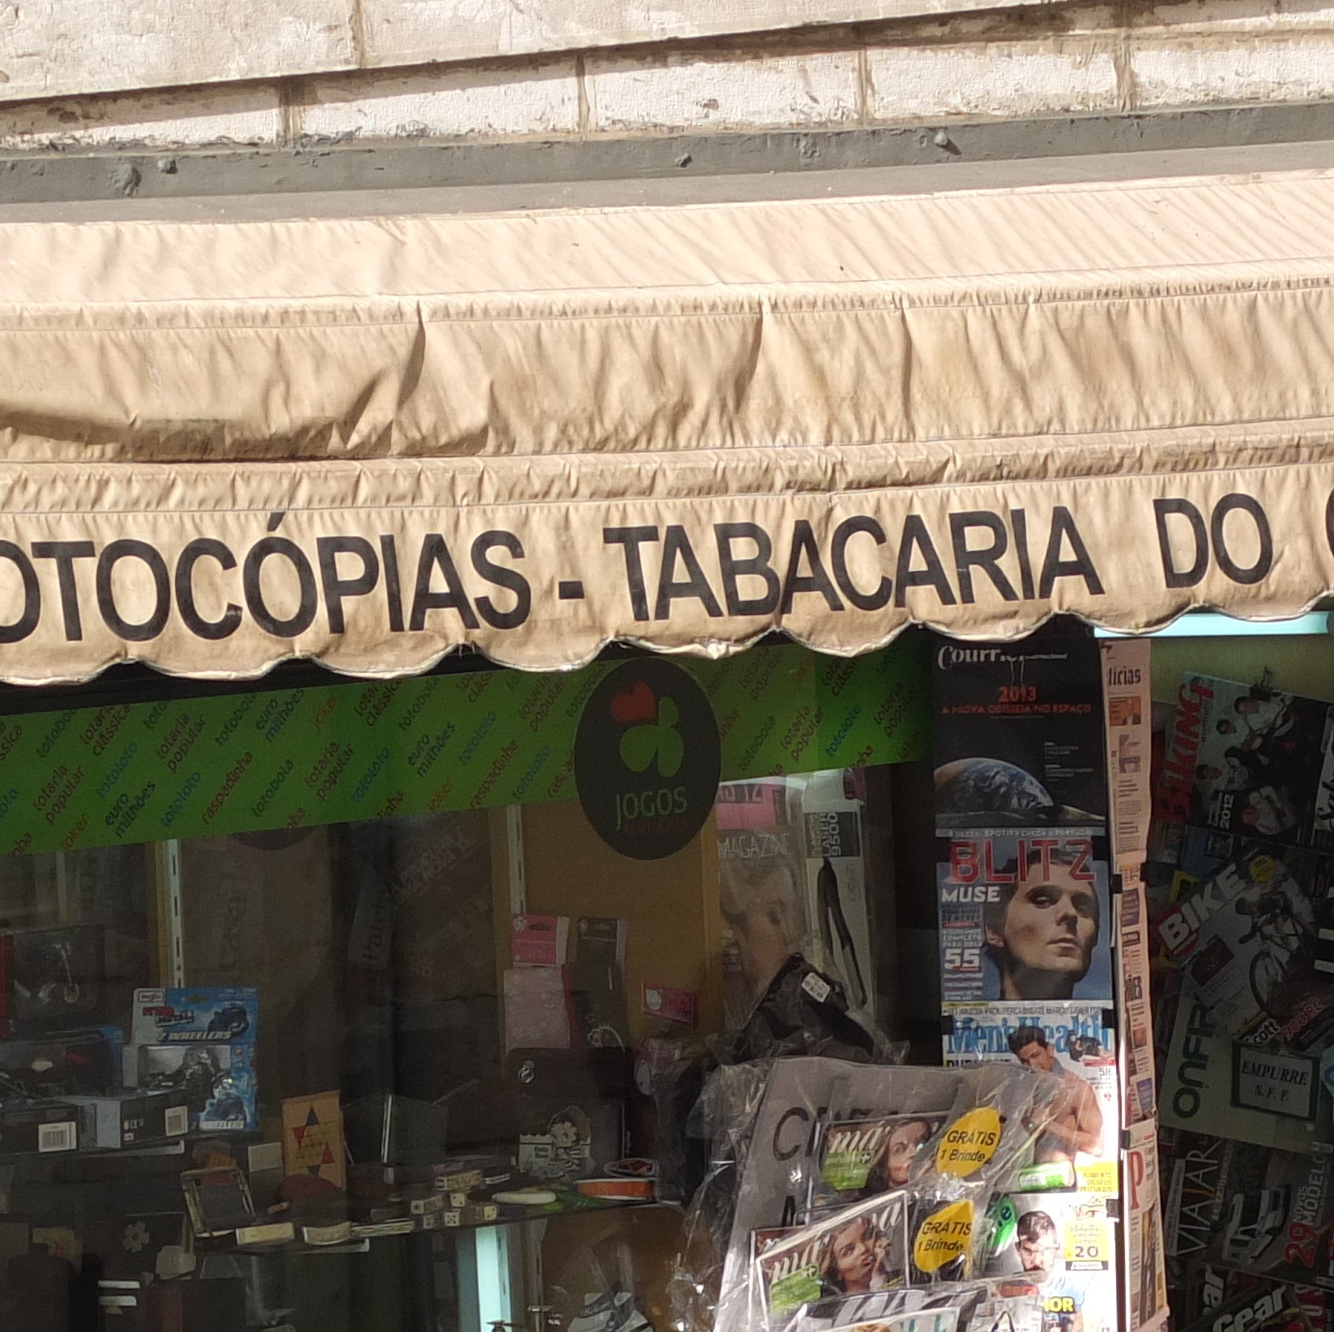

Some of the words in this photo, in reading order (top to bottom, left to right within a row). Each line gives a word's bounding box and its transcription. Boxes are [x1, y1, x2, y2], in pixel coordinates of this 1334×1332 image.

[603, 506, 1104, 622] TABACARIA
[1153, 493, 1272, 590] DO
[999, 685, 1036, 702] 2013
[616, 784, 689, 832] JOGOS
[950, 839, 1096, 884] BLITZ
[942, 886, 1000, 903] MUSE
[944, 948, 980, 969] 55
[1242, 1060, 1309, 1086] EMPURRE
[947, 1127, 997, 1146] GRÁTIS
